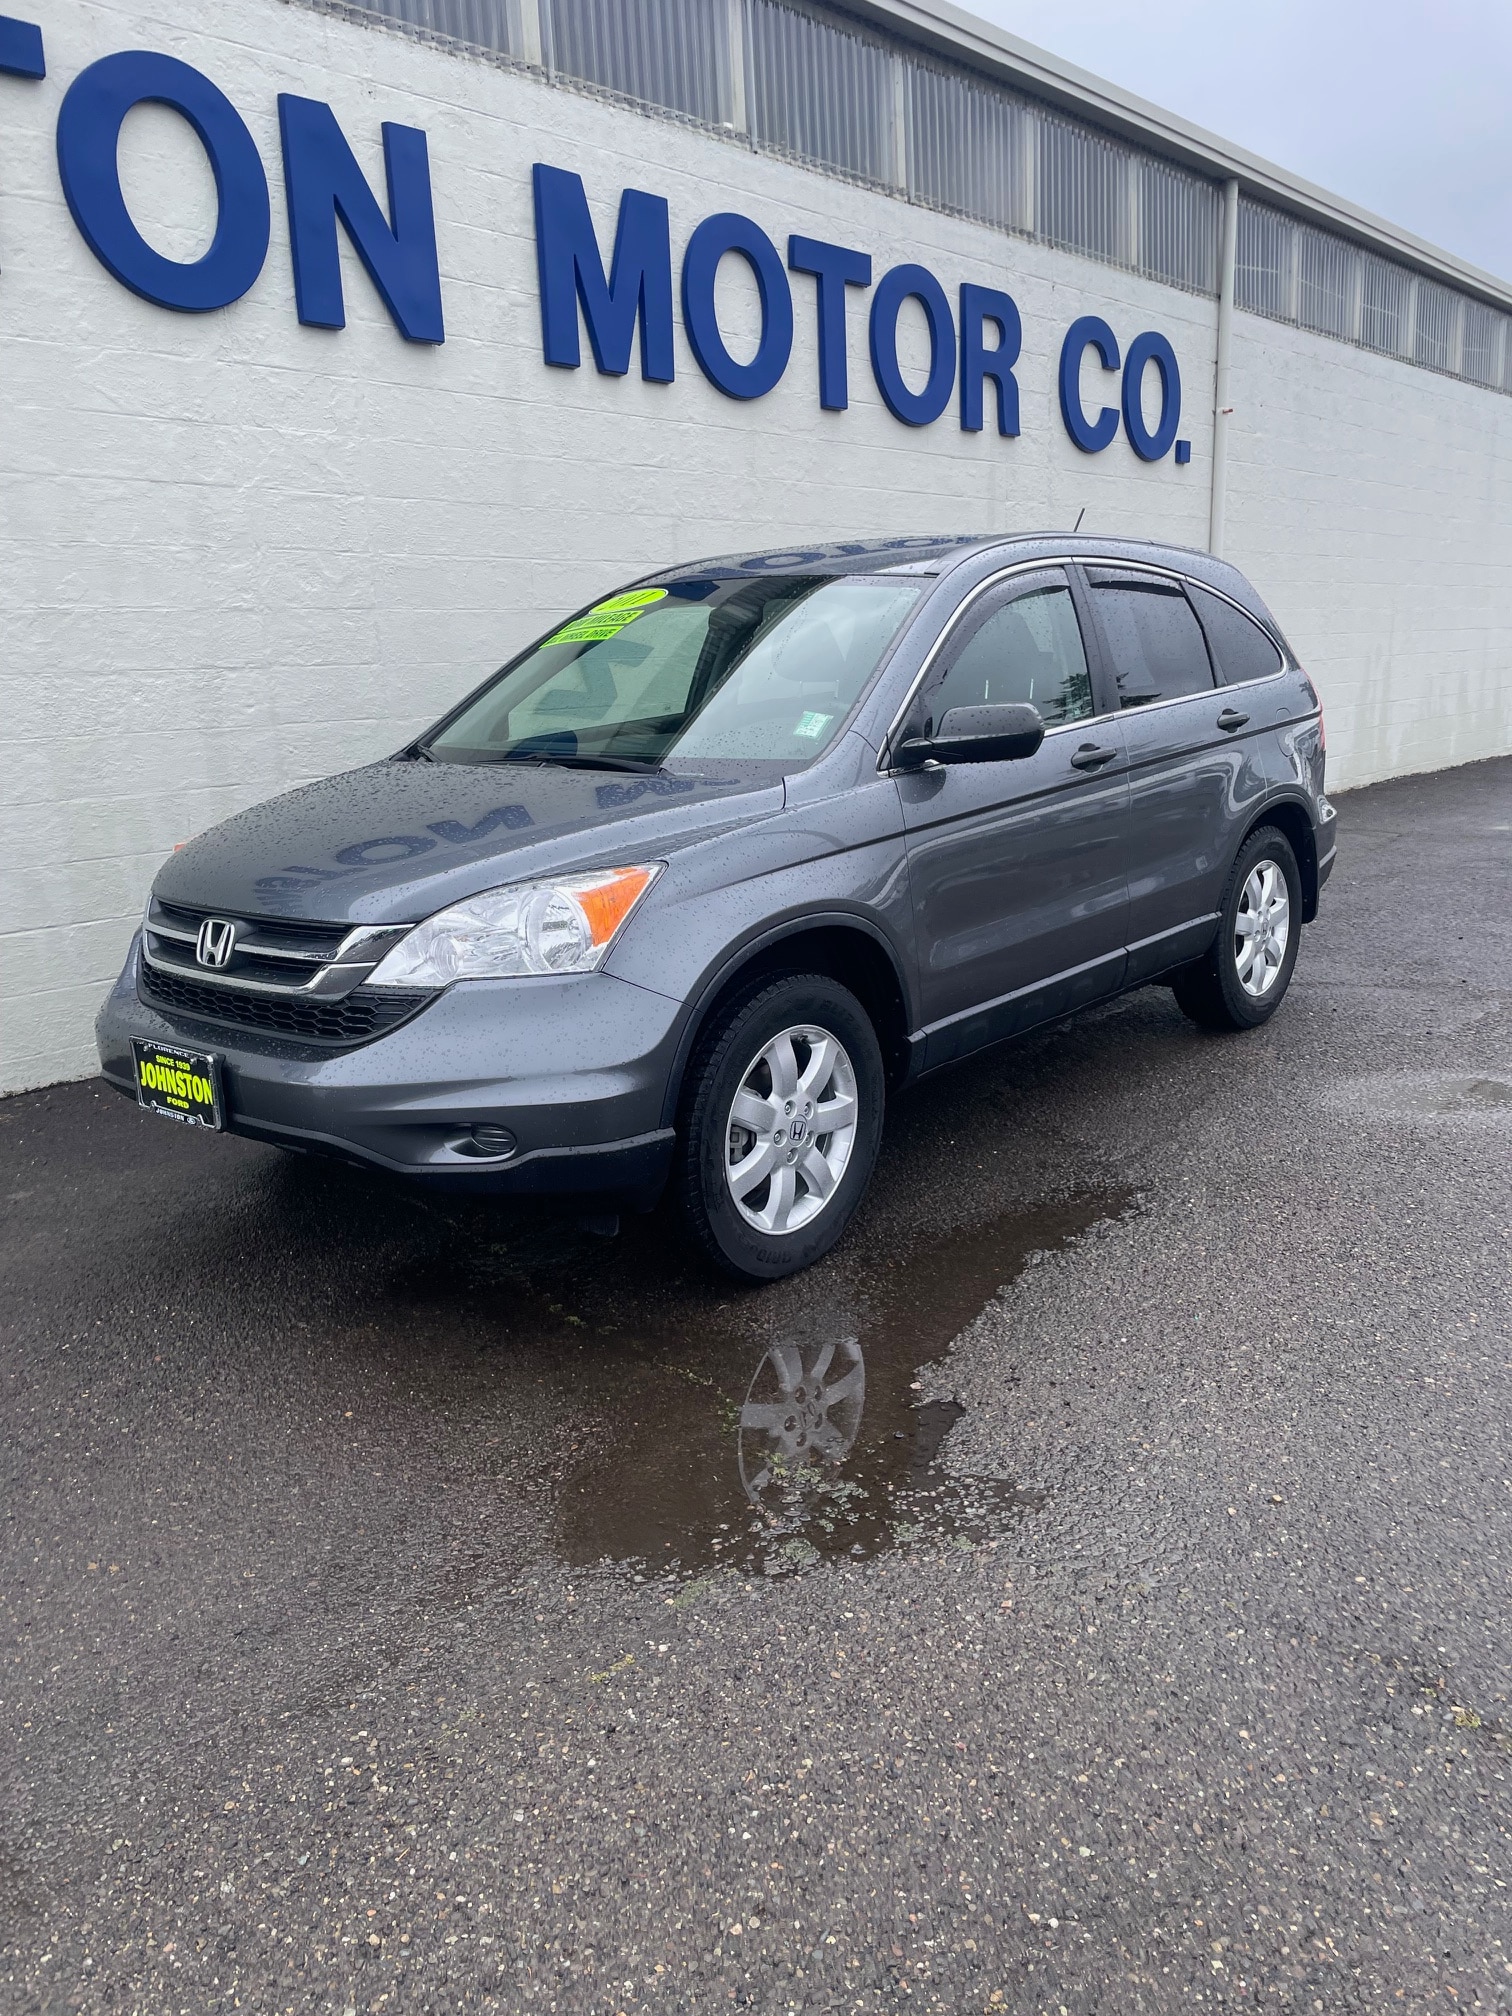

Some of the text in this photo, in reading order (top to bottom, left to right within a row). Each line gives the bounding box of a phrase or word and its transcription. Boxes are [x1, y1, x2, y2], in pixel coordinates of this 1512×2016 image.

[532, 162, 1022, 438] MOTOR
[1058, 315, 1191, 465] CO.
[583, 628, 617, 639] DRIVE
[155, 1055, 191, 1071] SINCE 1939
[140, 1060, 214, 1106] JOHNSTON
[166, 1096, 190, 1109] FORD
[156, 1107, 185, 1122] JOHNSTON
